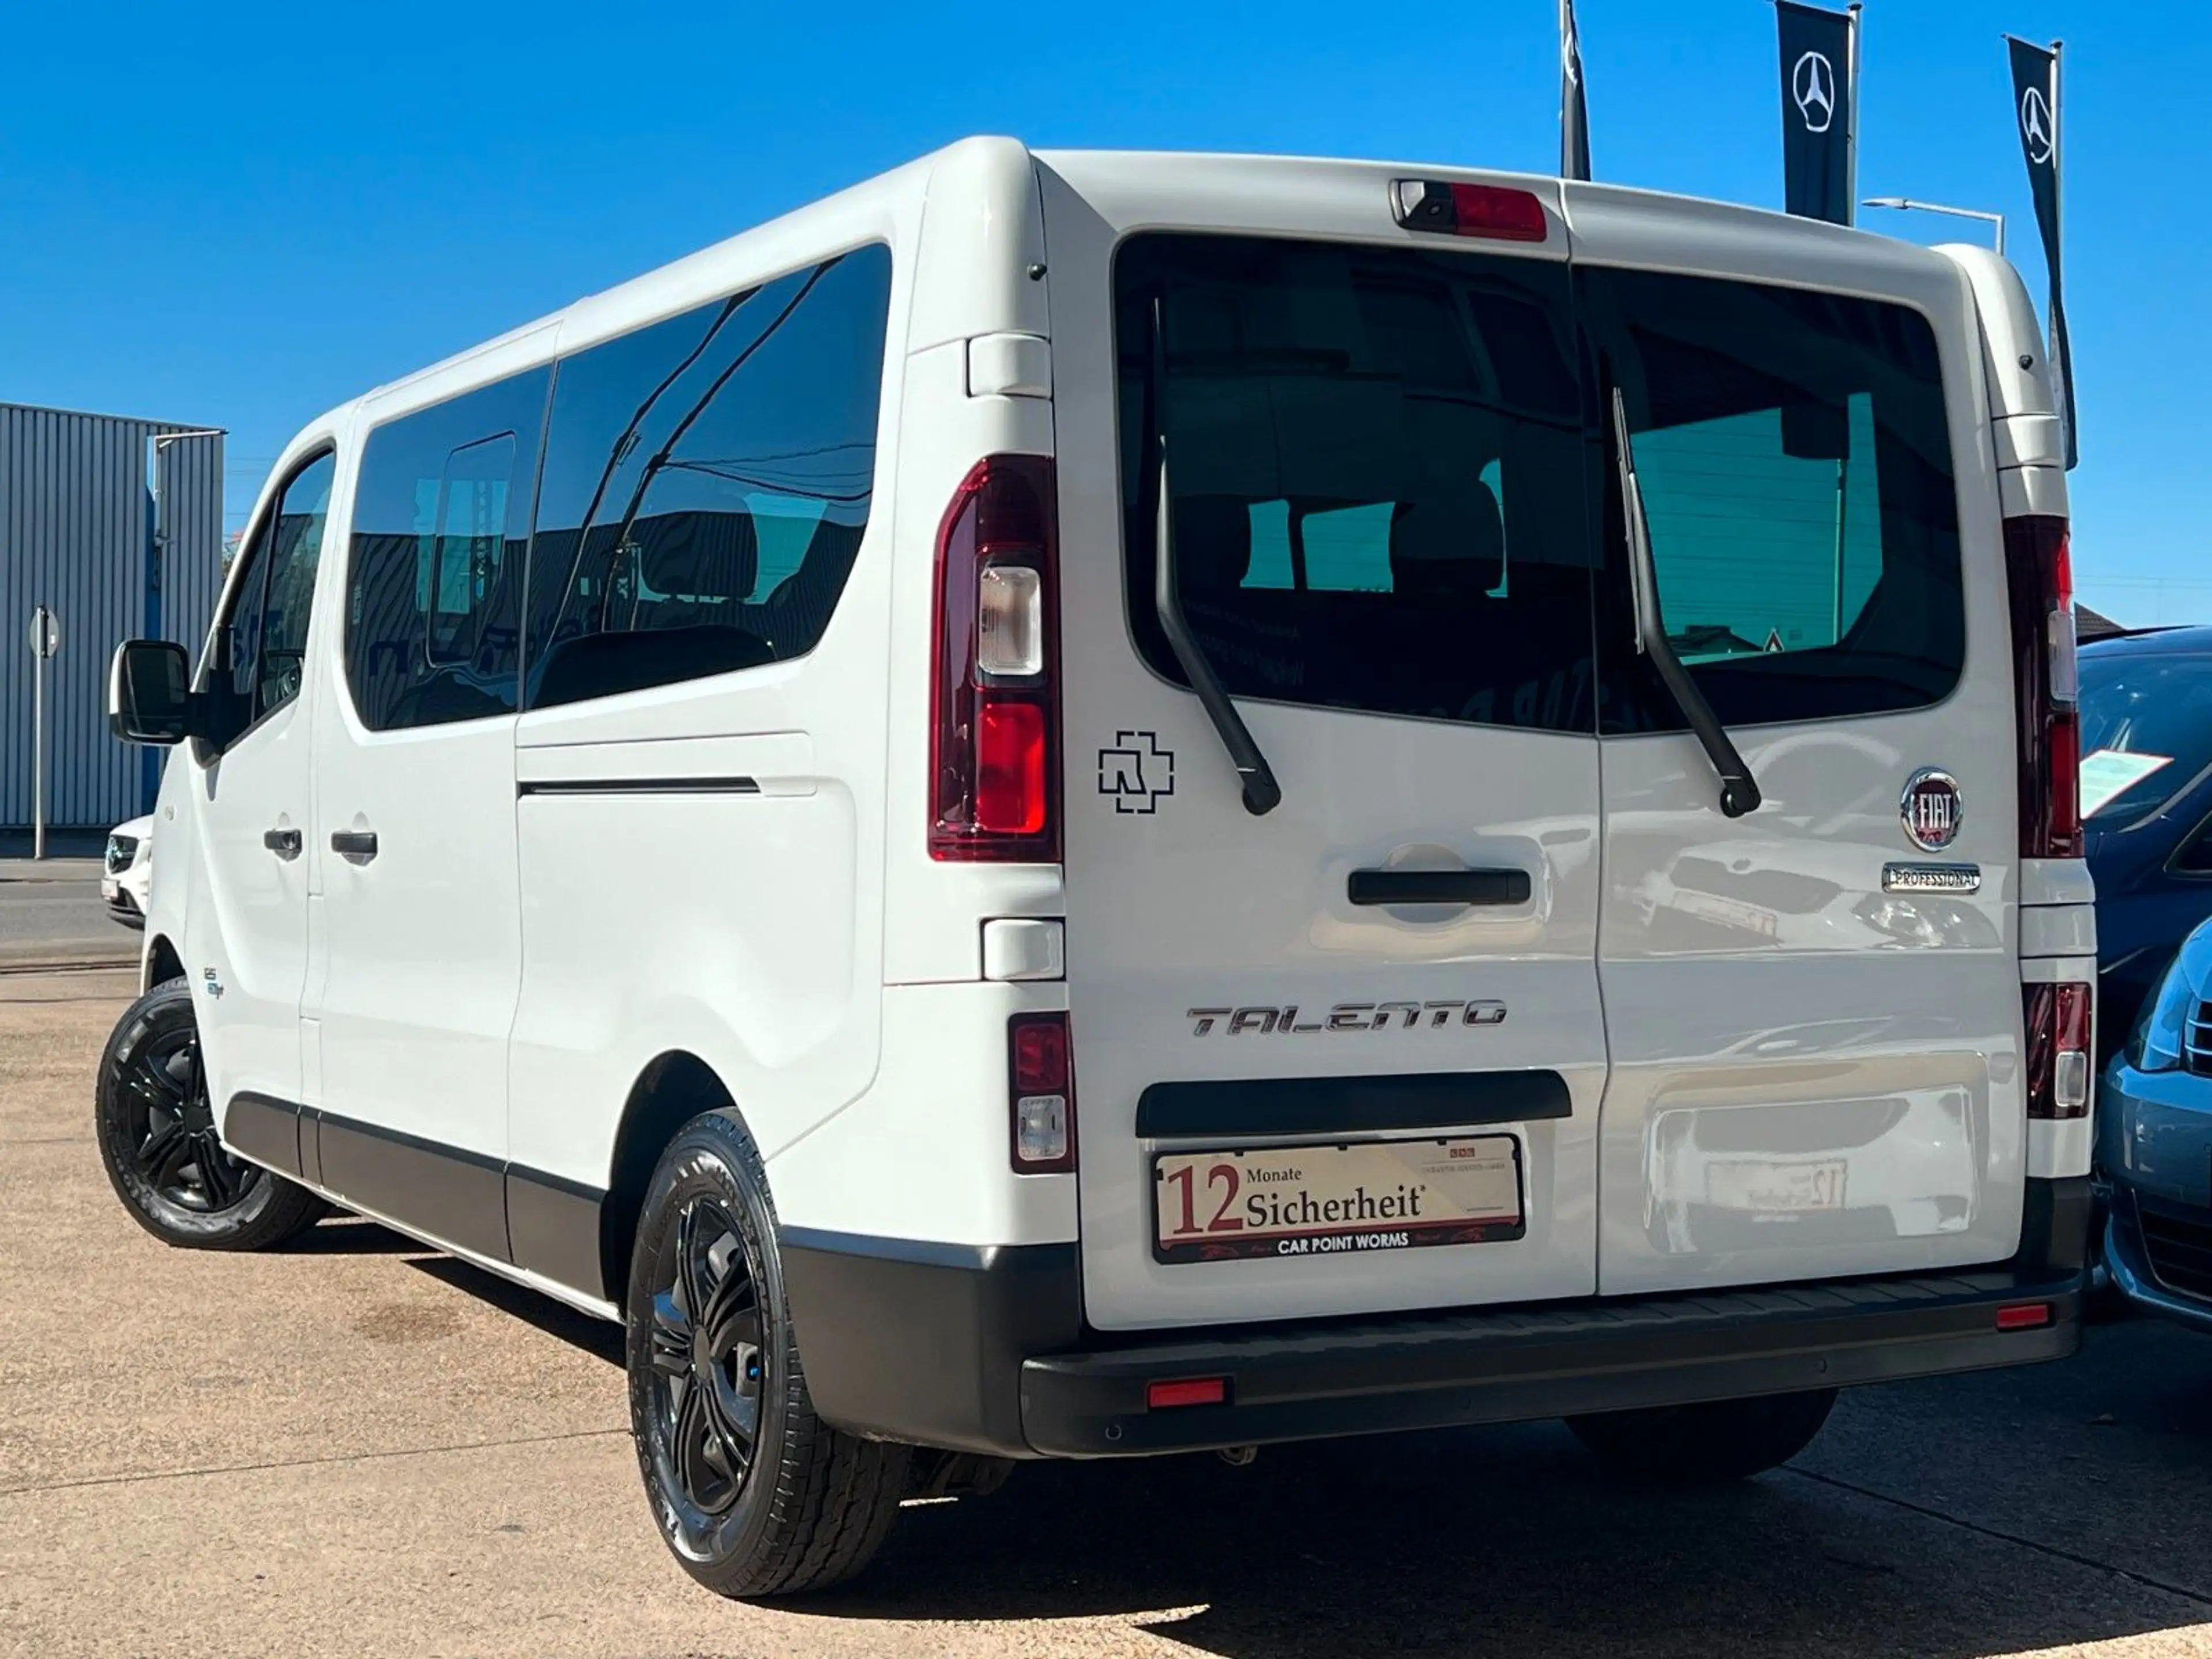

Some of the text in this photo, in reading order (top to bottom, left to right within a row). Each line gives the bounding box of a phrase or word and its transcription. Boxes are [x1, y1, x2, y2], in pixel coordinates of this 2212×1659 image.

[1919, 793, 1952, 829] FIAT
[1895, 869, 1977, 887] PROFESSIONAL
[1185, 999, 1508, 1037] TALENTO
[1246, 1168, 1302, 1184] Monate
[1166, 1164, 1244, 1234] 12
[1277, 1239, 1309, 1254] CAR
[1312, 1236, 1353, 1252] POINT
[1356, 1232, 1409, 1249] WORMS
